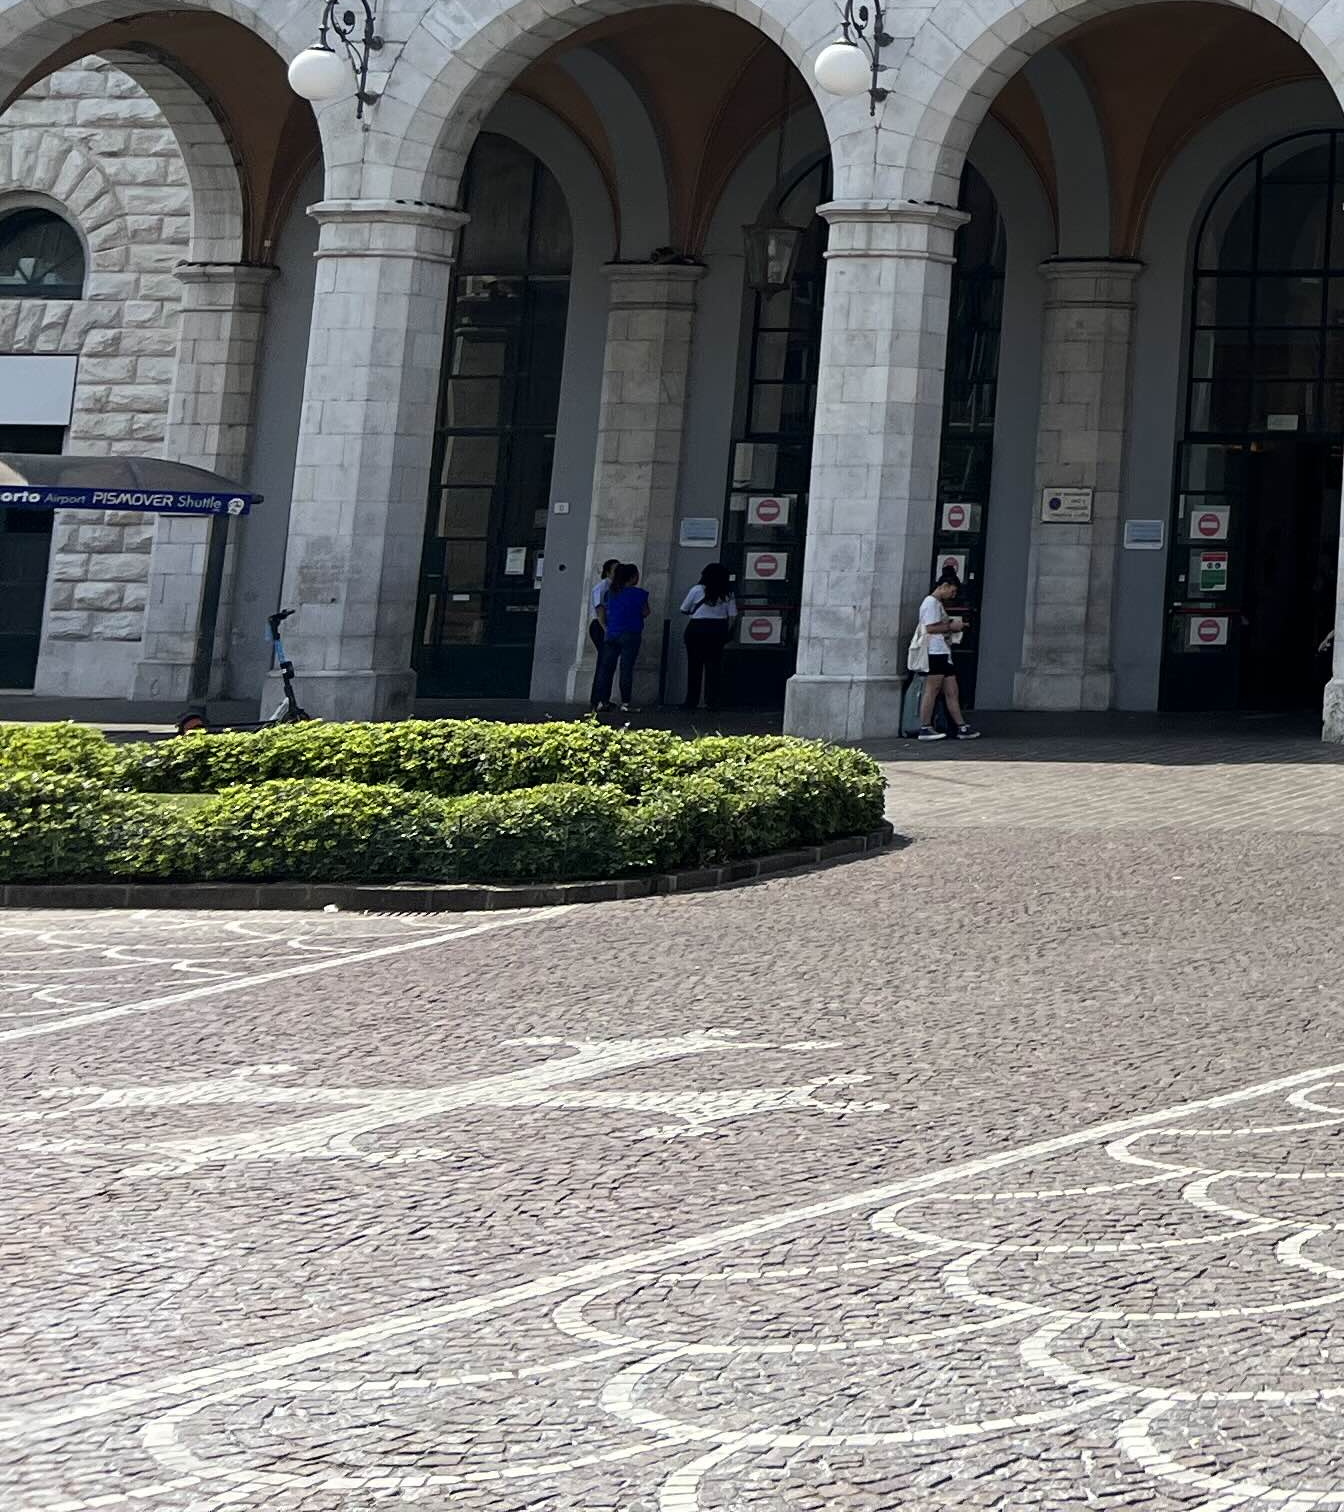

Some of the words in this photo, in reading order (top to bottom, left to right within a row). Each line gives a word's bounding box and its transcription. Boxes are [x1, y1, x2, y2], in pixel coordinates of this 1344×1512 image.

[44, 493, 86, 506] Airport
[92, 492, 174, 508] PISMOVER
[177, 497, 222, 510] Shuttle
